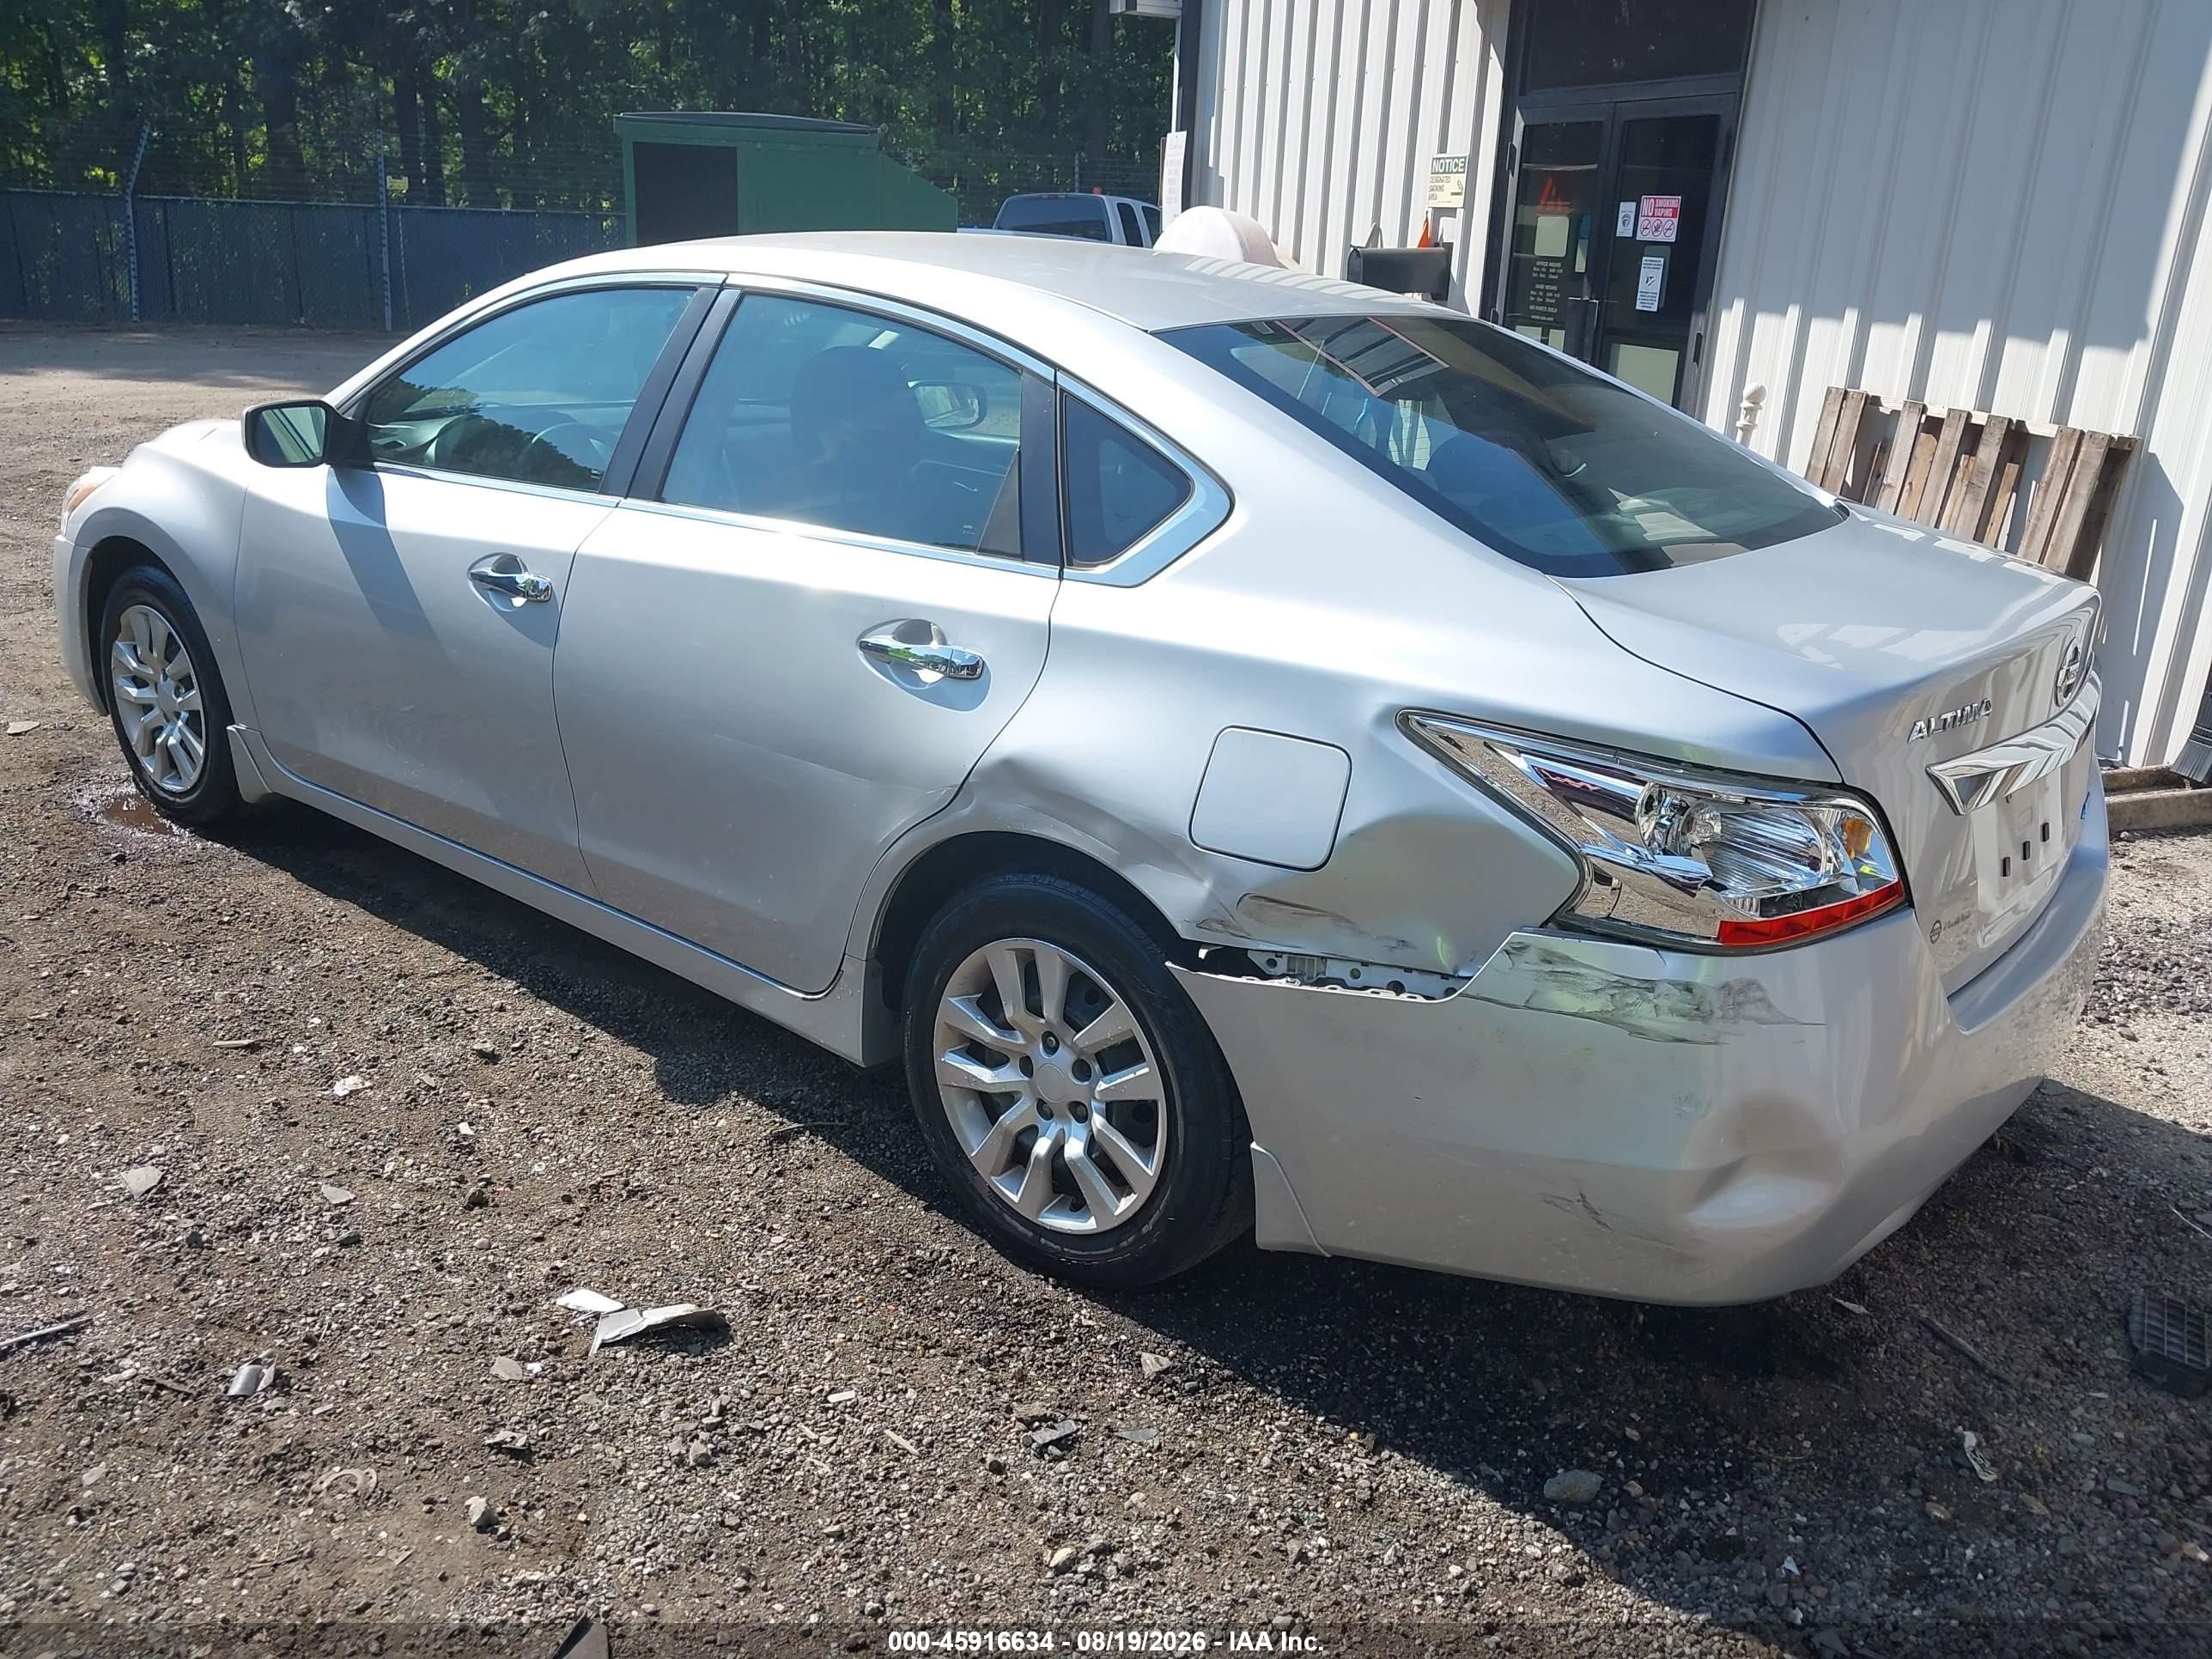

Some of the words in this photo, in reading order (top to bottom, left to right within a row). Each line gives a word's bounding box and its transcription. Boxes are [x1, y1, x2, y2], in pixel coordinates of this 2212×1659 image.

[1432, 158, 1465, 173] NOTICE
[1642, 198, 1655, 216] NO
[1655, 198, 1679, 208] SMOKING
[1907, 697, 1992, 743] ALTIMA
